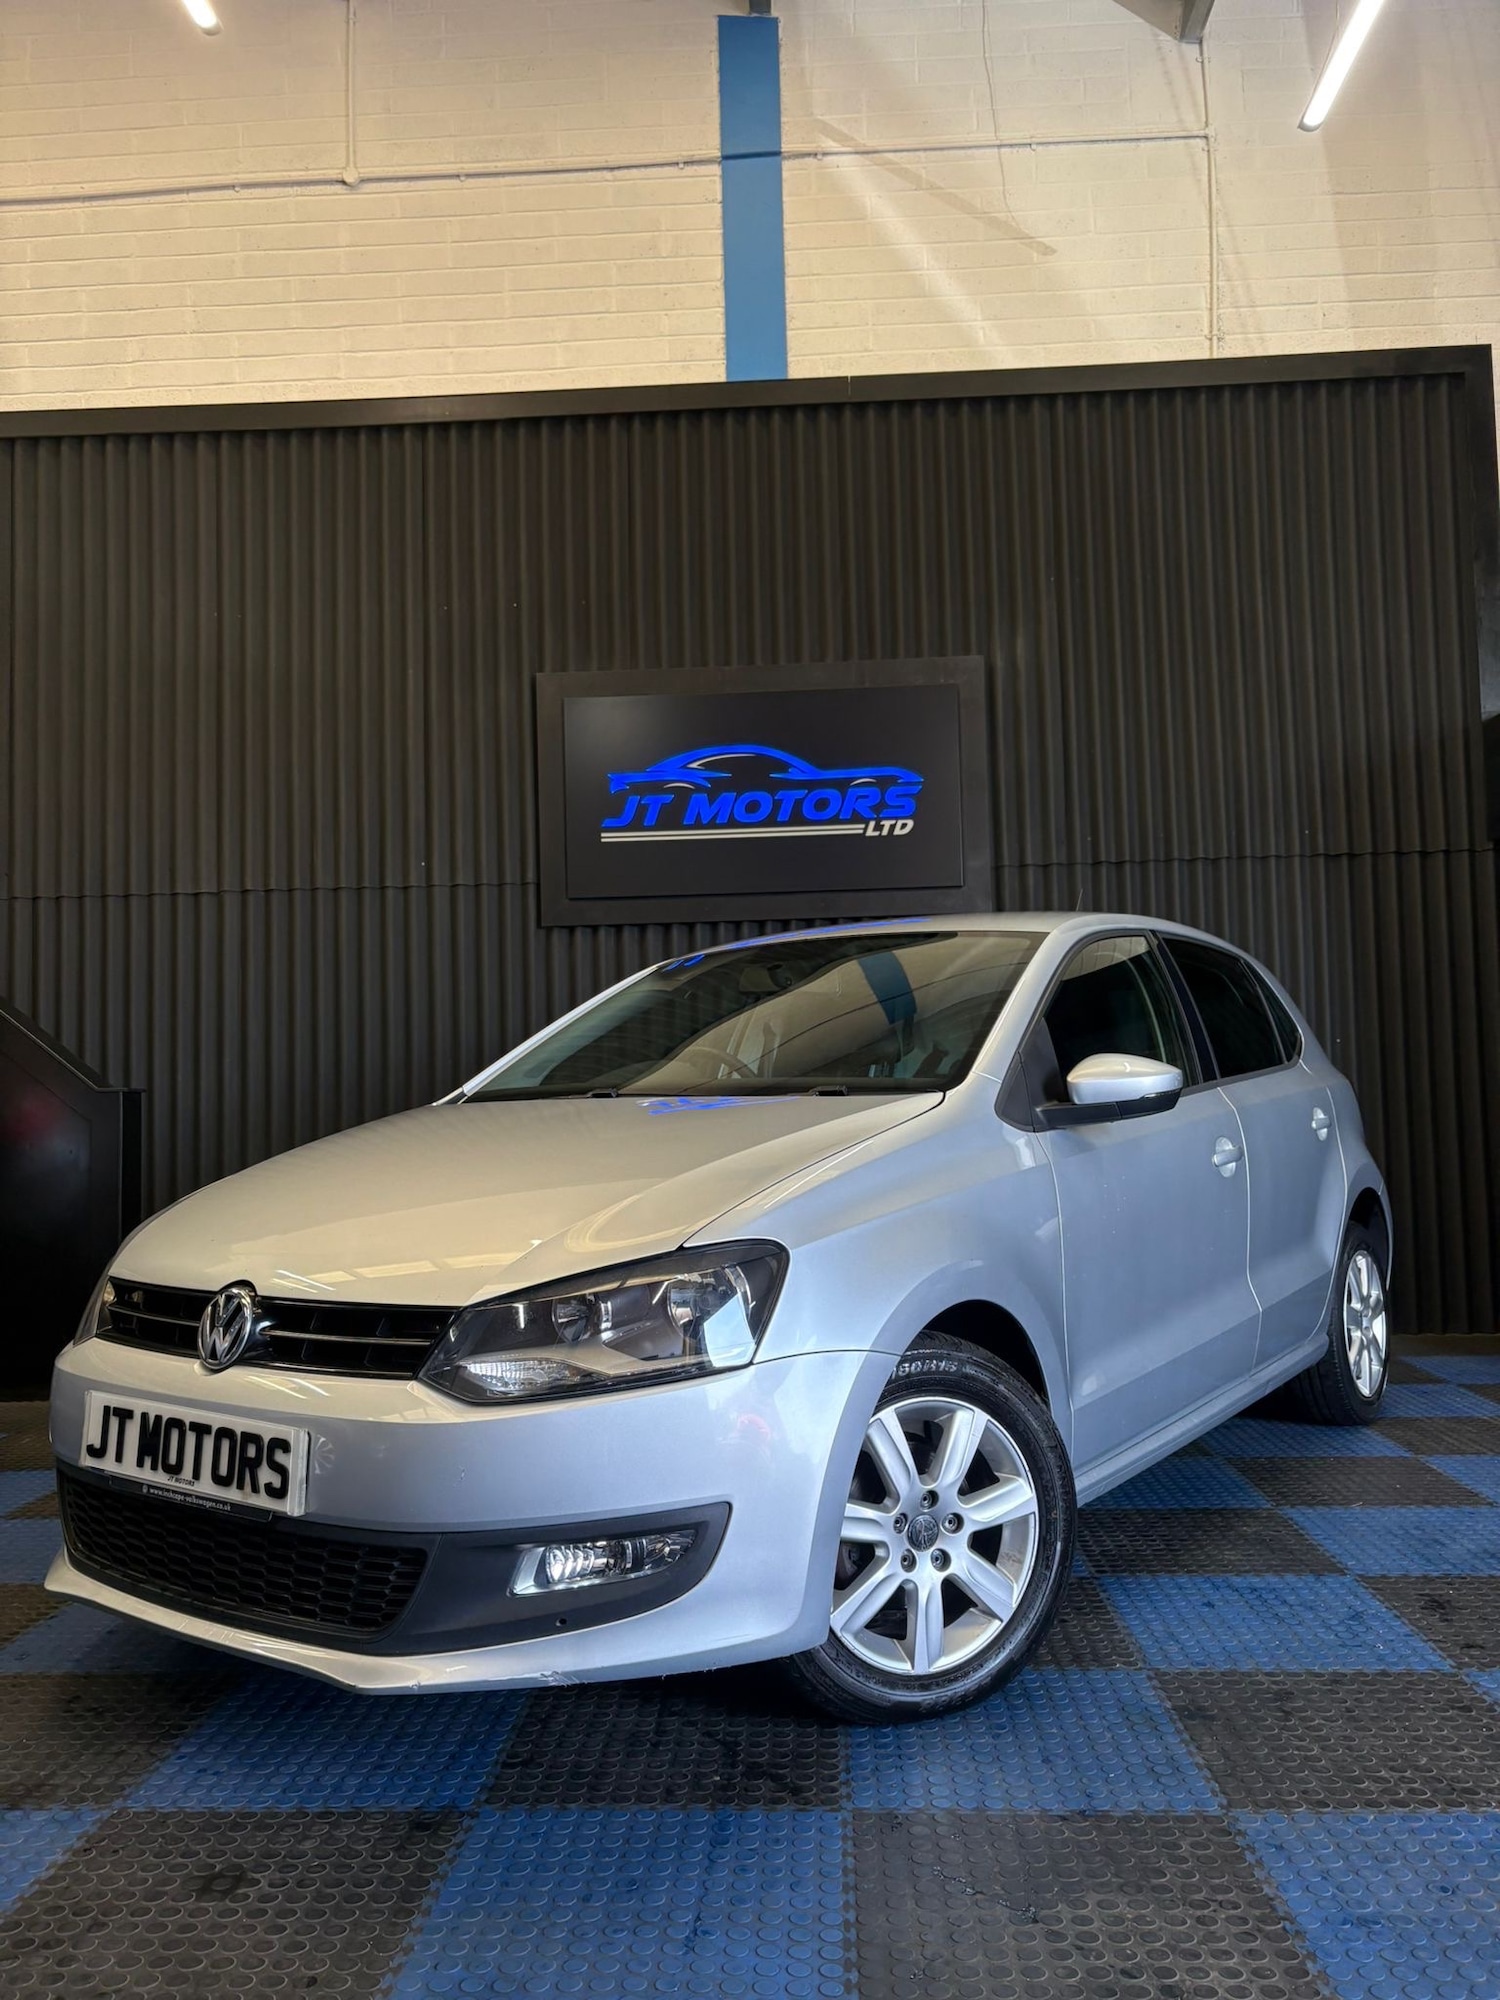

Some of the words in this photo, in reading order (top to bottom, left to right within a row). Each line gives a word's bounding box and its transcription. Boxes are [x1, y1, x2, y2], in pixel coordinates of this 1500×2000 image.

[601, 794, 674, 828] JT
[683, 785, 923, 826] MOTORS
[864, 819, 914, 837] LTD
[86, 1405, 134, 1464] JT
[136, 1411, 292, 1500] MOTORS
